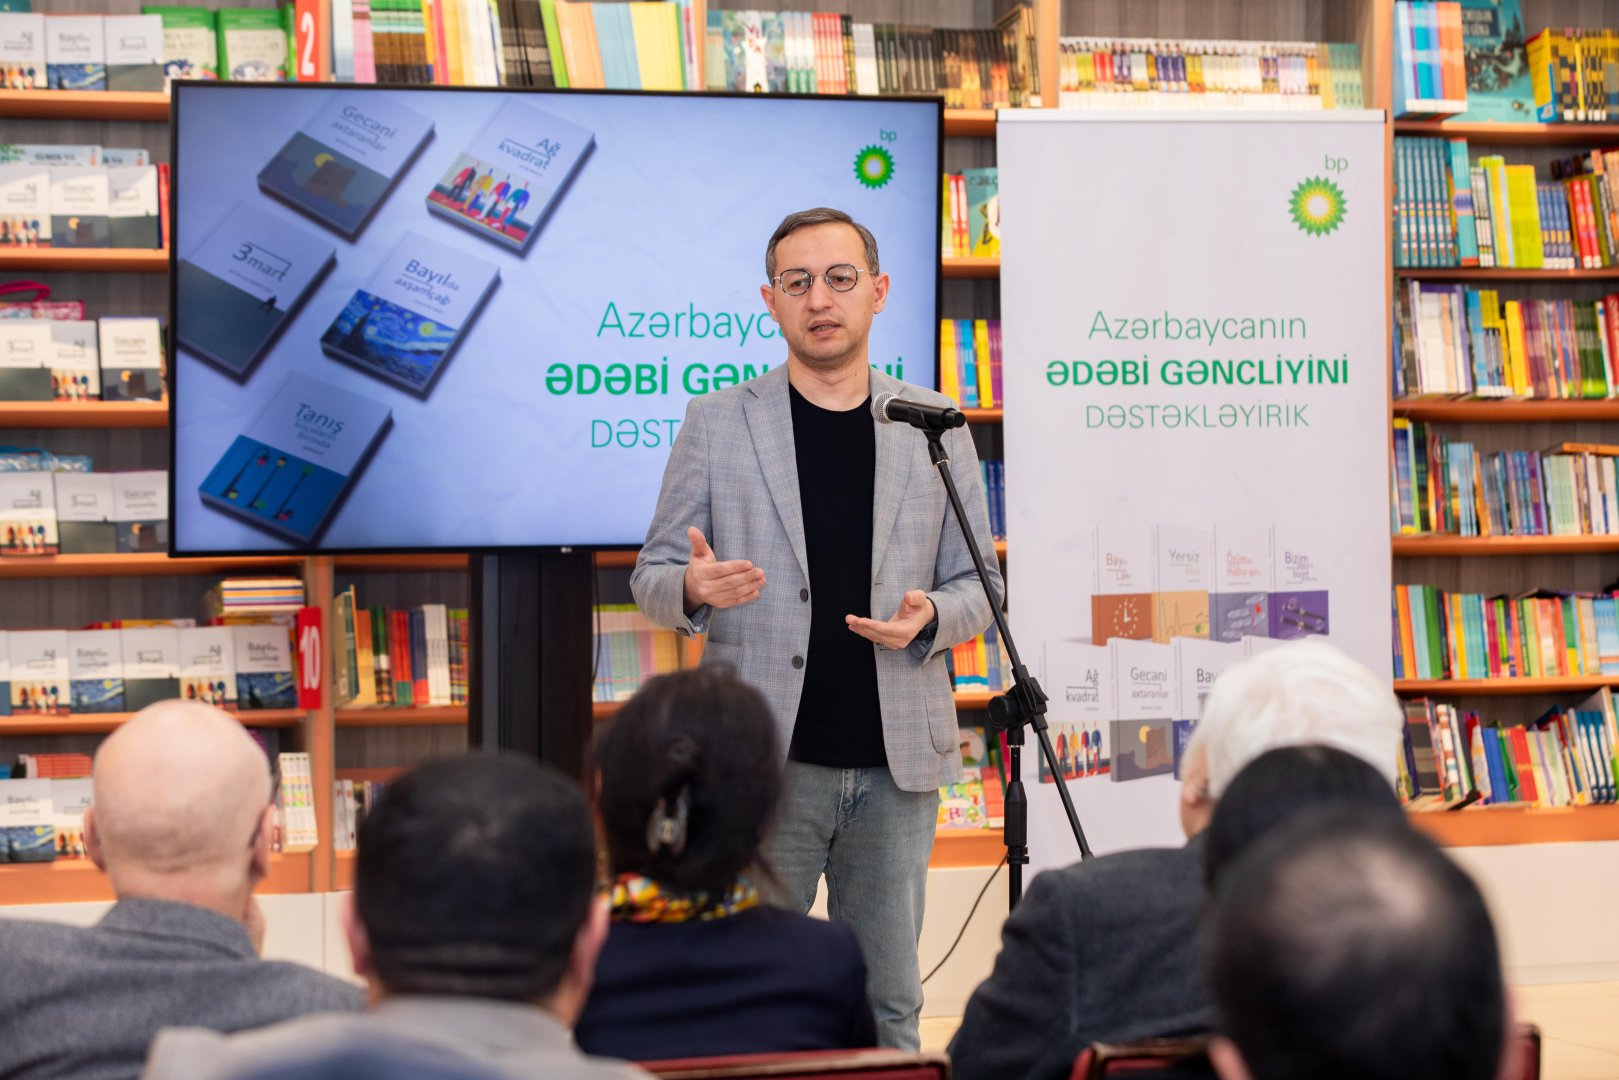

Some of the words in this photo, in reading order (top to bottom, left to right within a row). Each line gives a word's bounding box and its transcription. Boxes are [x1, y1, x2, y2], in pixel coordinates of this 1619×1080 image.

[301, 11, 315, 76] 2
[536, 138, 561, 157] Ağ
[880, 128, 897, 143] bp
[497, 140, 551, 170] kvadrat
[1325, 153, 1348, 174] bp
[597, 301, 784, 347] Azərbayc
[1088, 310, 1306, 346] Azərbaycanın
[545, 355, 669, 396] ƏDƏBİ
[1046, 354, 1149, 386] ƏDƏBİ
[1160, 353, 1349, 386] GƏNCLİYİNİ
[1085, 399, 1310, 429] DƏSTƏKLƏYİRİK
[591, 418, 681, 449] DƏST
[1168, 549, 1201, 563] Yersiz
[1284, 552, 1310, 564] Bizim
[299, 625, 321, 690] 10
[1084, 669, 1099, 687] Ağ
[1065, 689, 1100, 703] kvadrat
